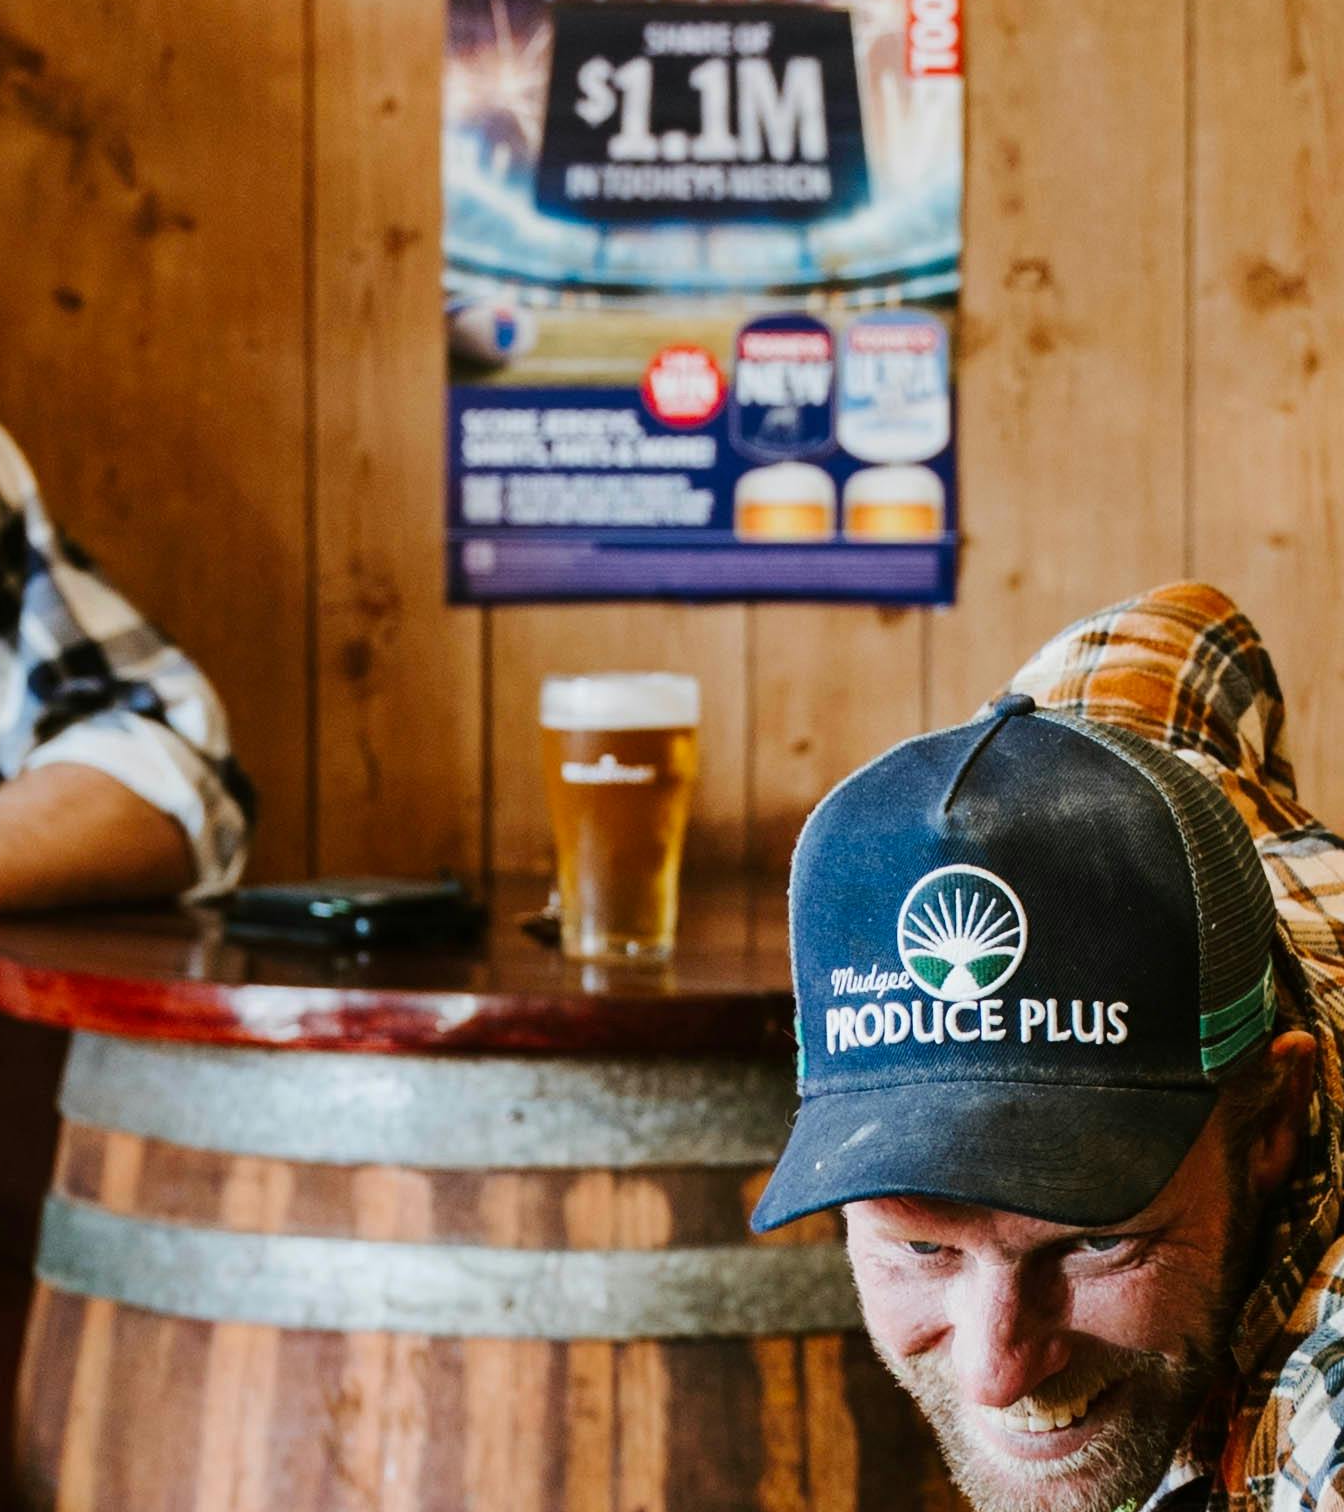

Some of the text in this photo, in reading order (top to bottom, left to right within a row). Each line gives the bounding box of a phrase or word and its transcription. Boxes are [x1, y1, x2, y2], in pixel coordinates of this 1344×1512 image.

[574, 54, 830, 163] $1.1M
[736, 360, 833, 407] NEW
[830, 963, 915, 1001] Mudgee
[826, 998, 1129, 1056] PRODUCE PLUS
